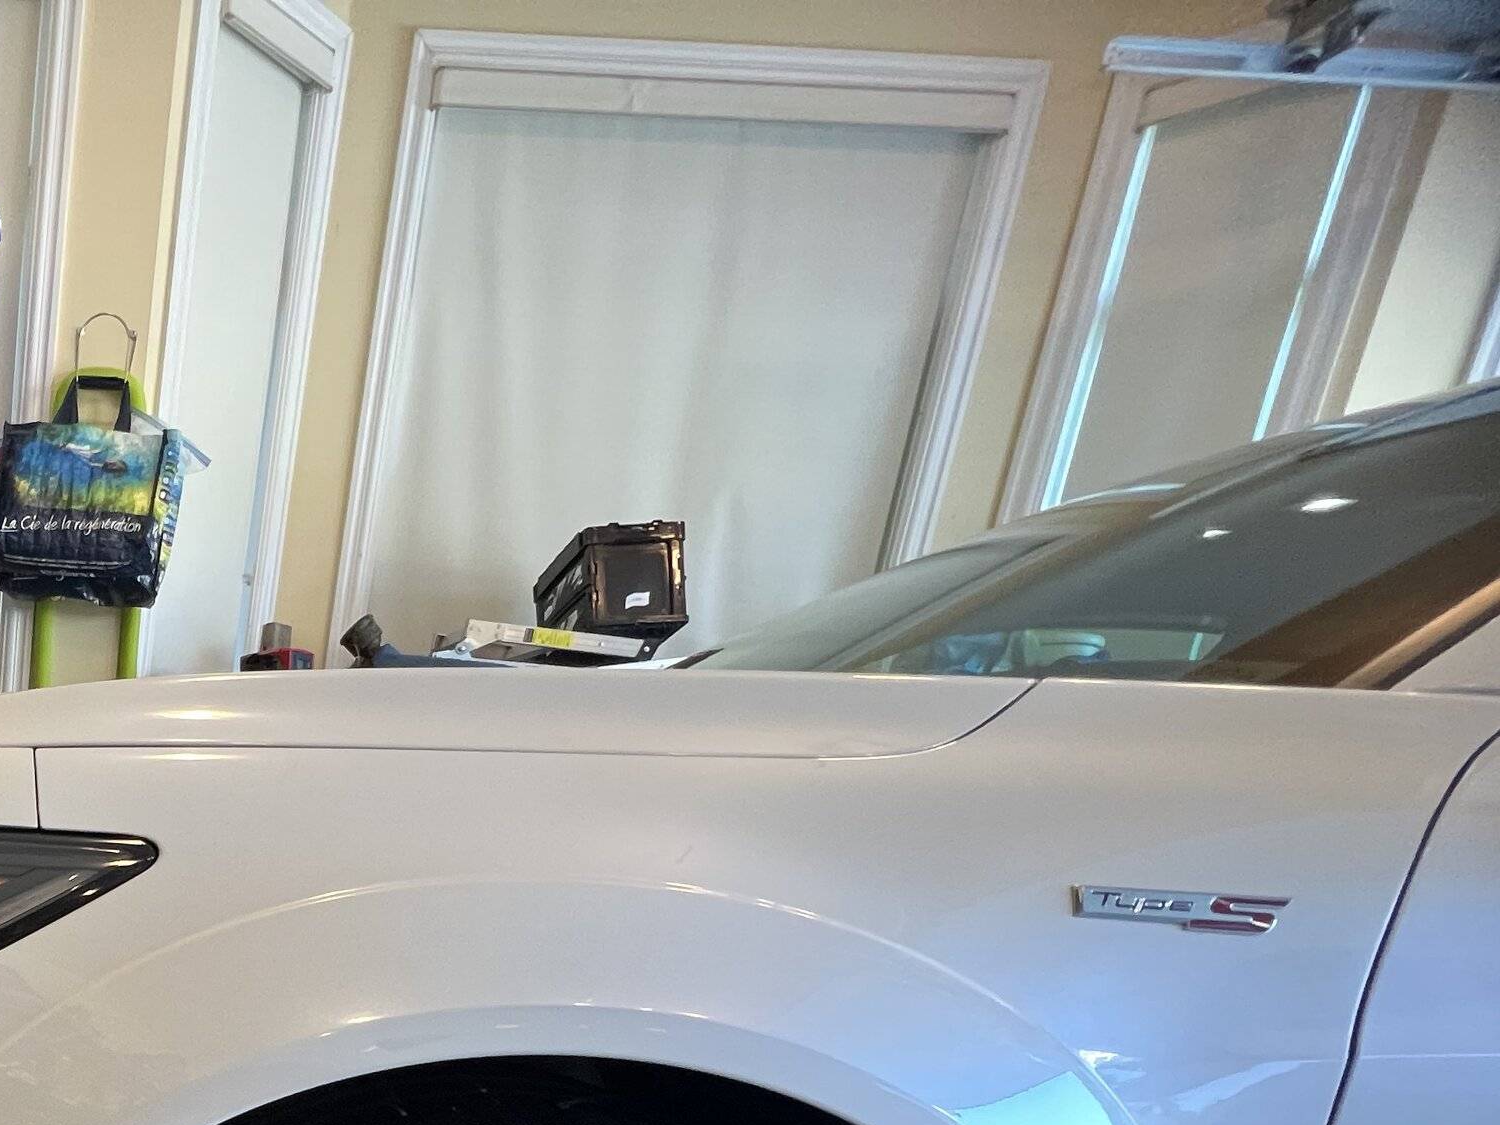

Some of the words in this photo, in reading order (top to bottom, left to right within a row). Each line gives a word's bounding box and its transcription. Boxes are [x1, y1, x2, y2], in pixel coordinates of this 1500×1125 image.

[1, 516, 18, 532] La
[20, 514, 41, 531] Cie
[44, 515, 58, 531] de
[61, 515, 72, 531] la
